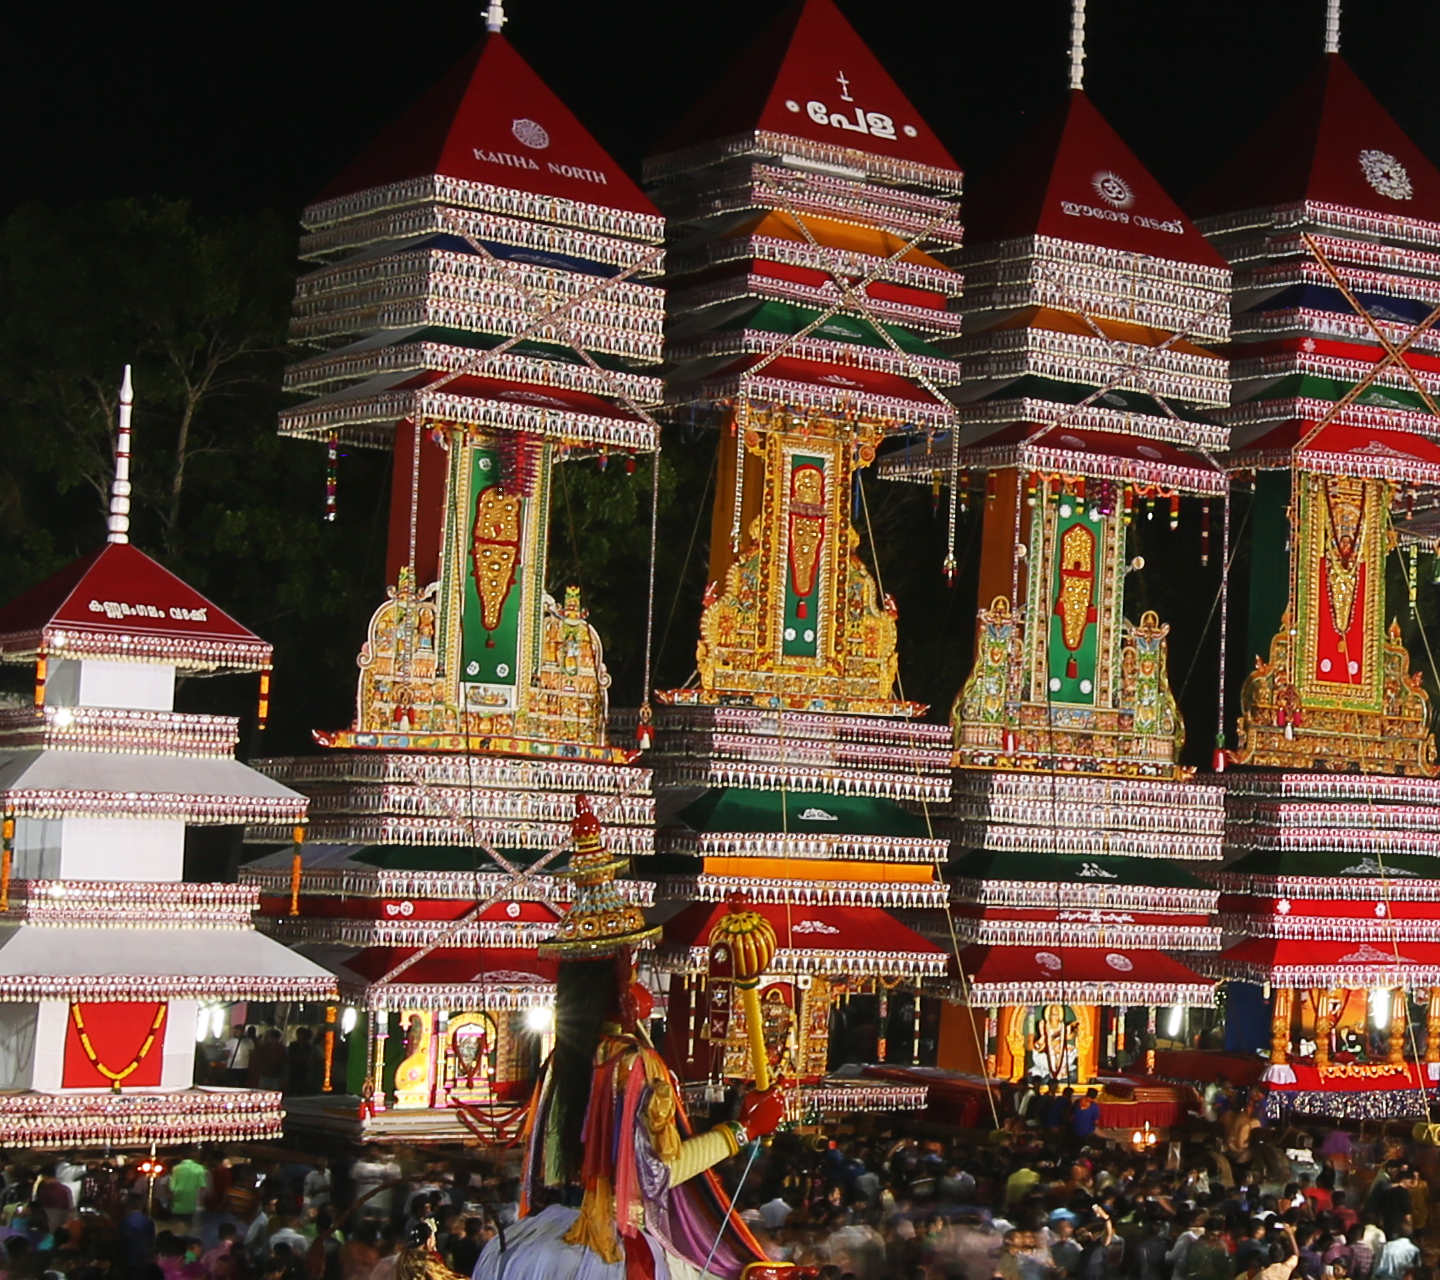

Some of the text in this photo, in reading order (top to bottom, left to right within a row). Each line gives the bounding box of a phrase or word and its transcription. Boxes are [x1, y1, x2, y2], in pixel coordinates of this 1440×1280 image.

[806, 100, 898, 141] പേള
[473, 148, 608, 185] KAITHA NORTH
